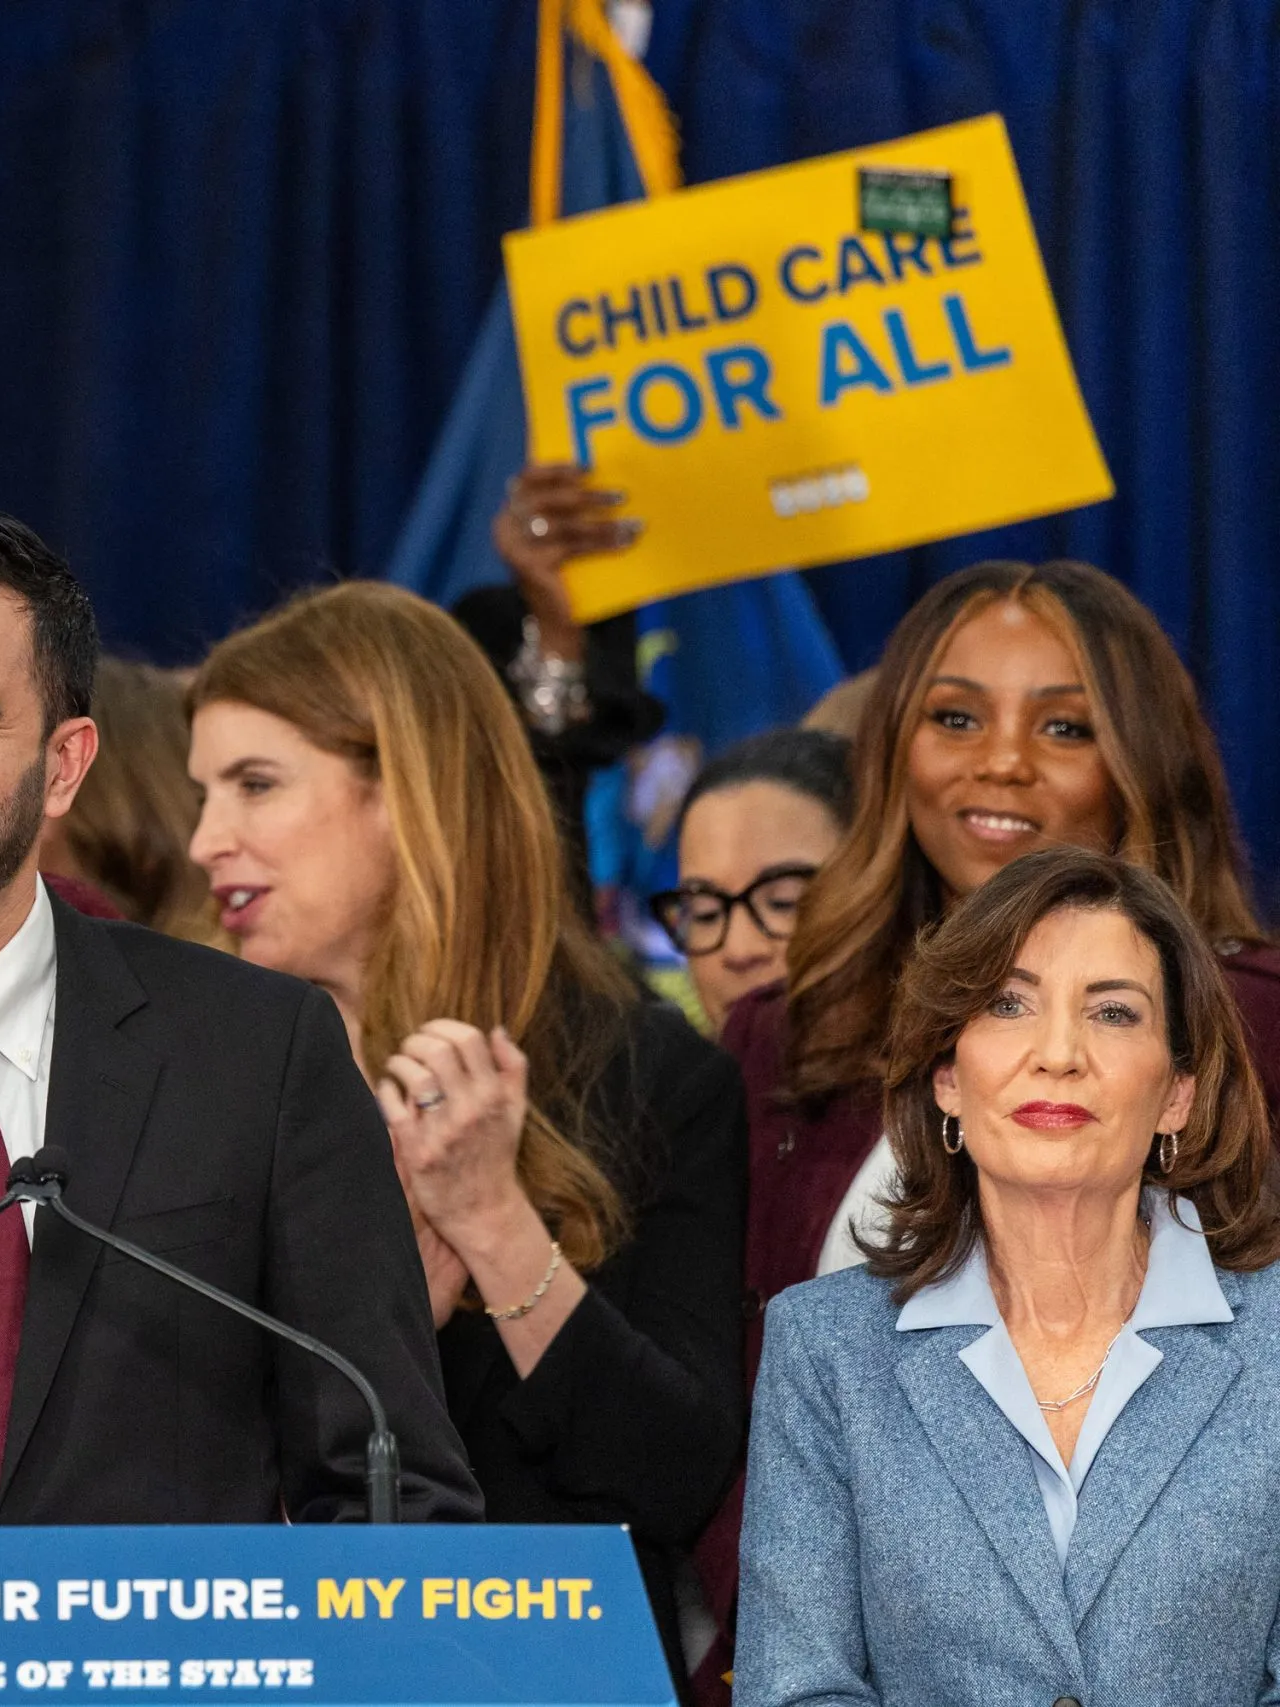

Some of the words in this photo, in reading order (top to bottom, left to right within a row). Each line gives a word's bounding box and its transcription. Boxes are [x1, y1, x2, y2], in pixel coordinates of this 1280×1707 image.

[557, 263, 759, 358] CHILD
[778, 206, 983, 303] CARE
[565, 344, 782, 469] FOR
[820, 295, 1013, 406] ALL
[57, 1578, 300, 1621] FUTURE.
[317, 1578, 406, 1620] MY
[422, 1577, 603, 1620] FIGHT.
[16, 1660, 73, 1689] OF
[82, 1659, 171, 1688] THE
[179, 1659, 314, 1688] STATE
